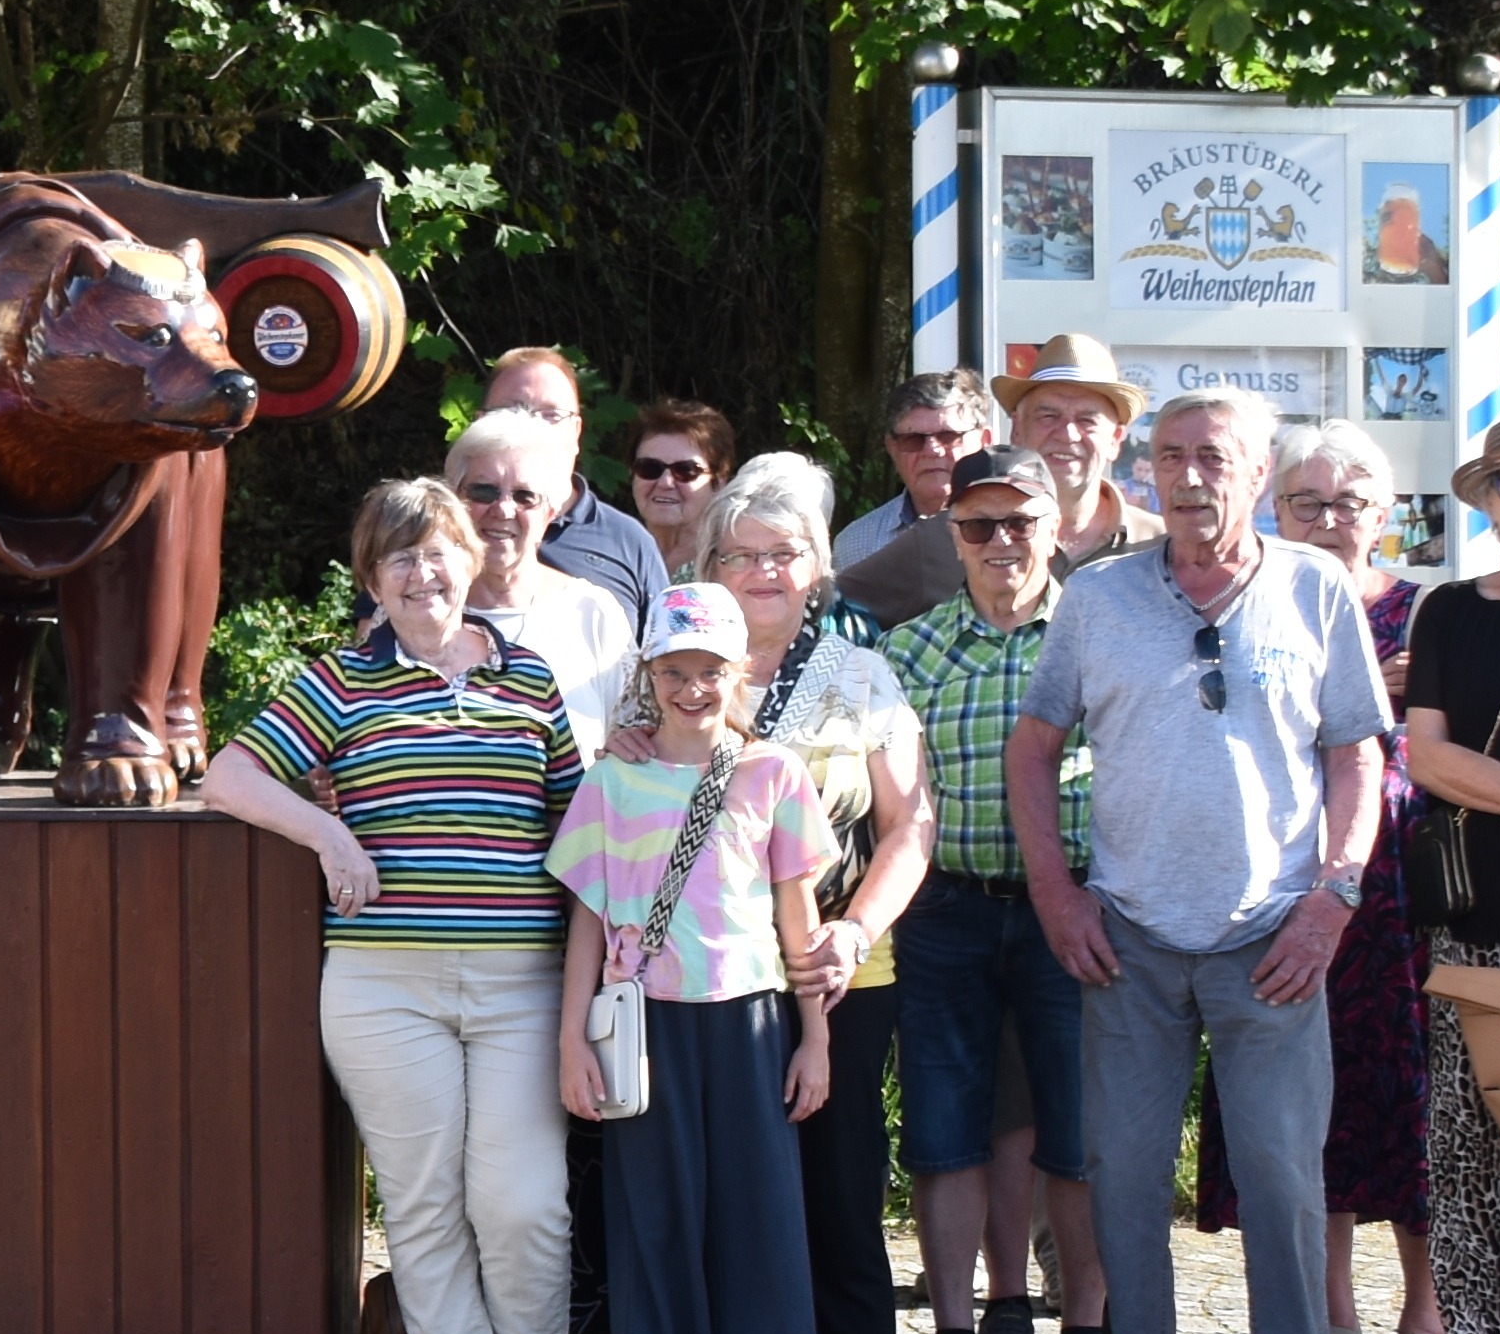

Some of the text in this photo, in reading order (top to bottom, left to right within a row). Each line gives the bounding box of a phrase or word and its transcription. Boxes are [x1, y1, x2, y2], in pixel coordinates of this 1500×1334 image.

[1132, 141, 1326, 205] BRÄUSTÜBERL
[1140, 268, 1316, 307] Weihenstephan
[1177, 363, 1299, 393] Genuss
